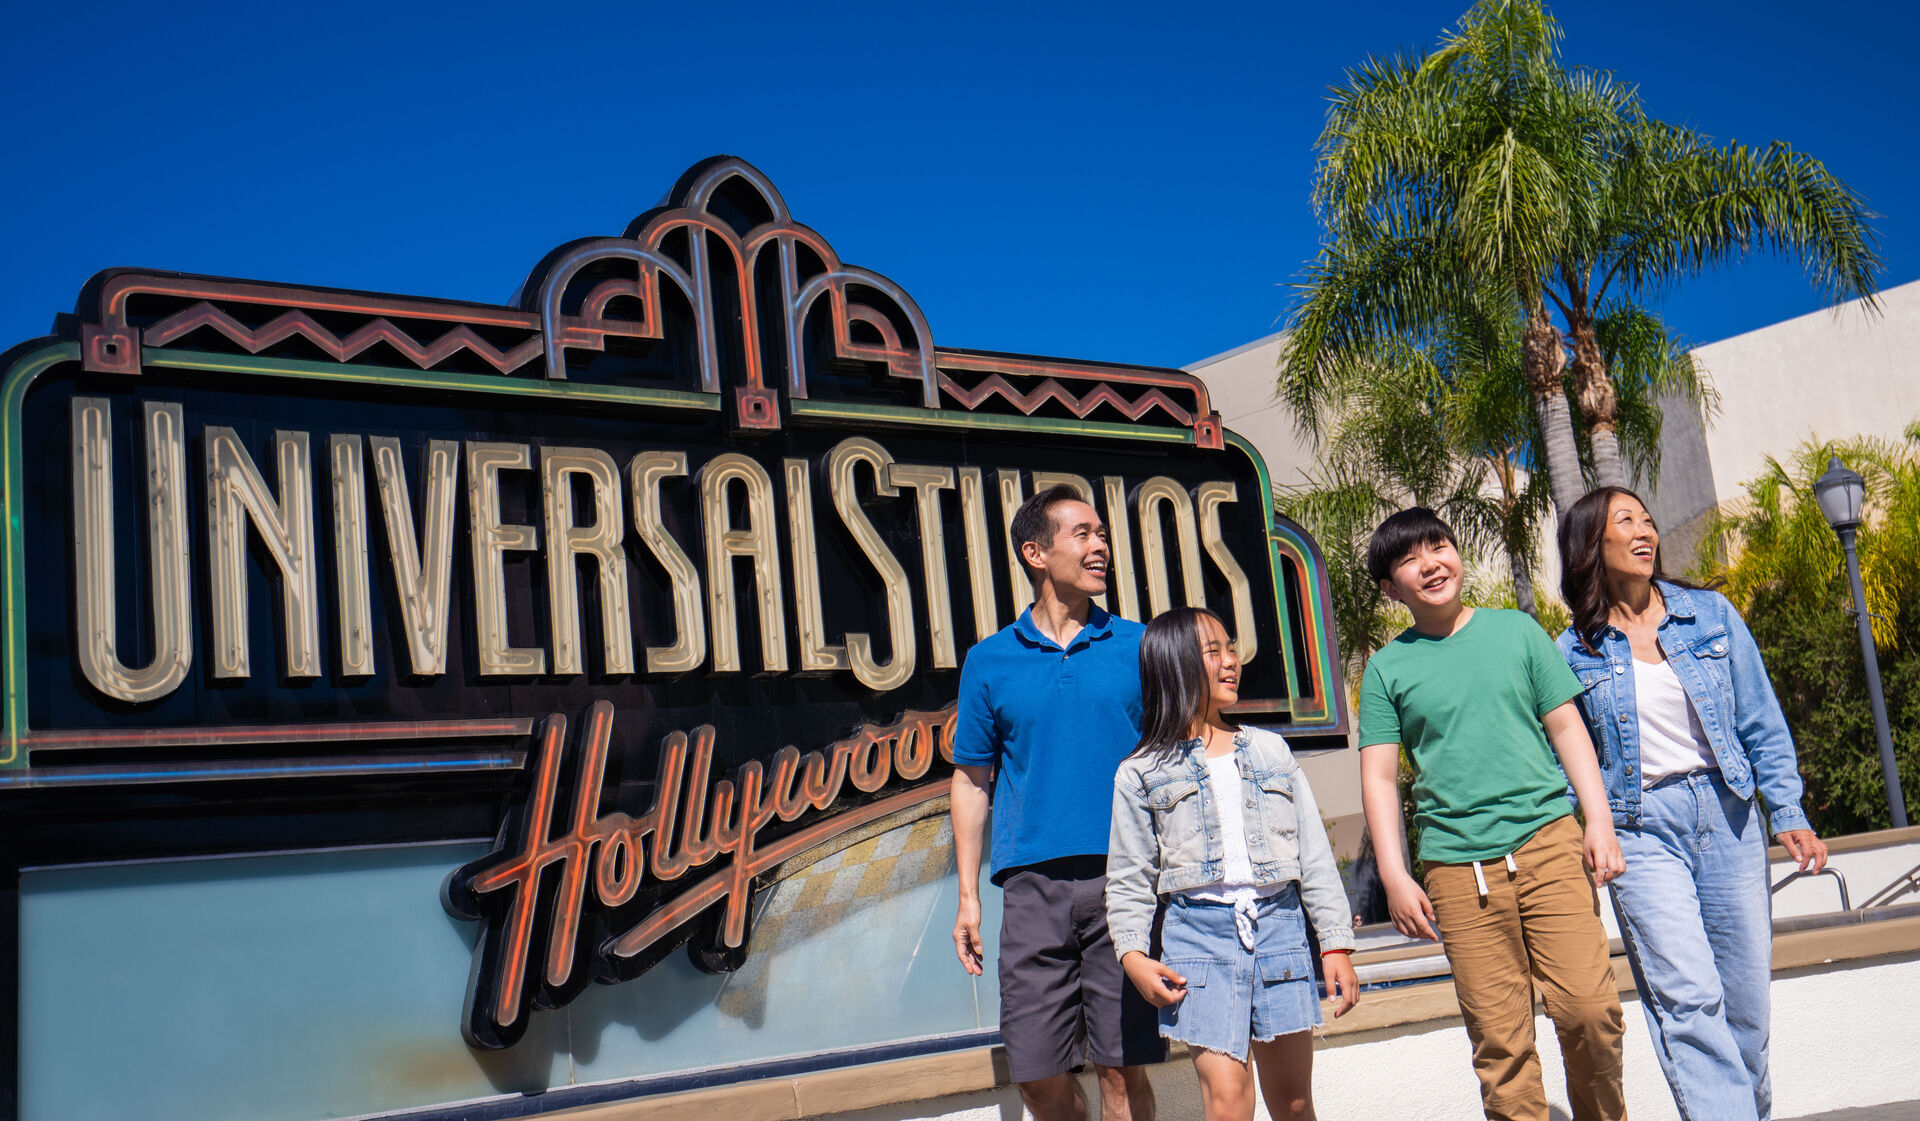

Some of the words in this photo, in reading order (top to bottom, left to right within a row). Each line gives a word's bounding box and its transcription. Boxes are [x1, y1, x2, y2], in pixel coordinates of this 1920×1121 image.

[71, 396, 850, 703] UNIVERSAL
[828, 436, 1258, 691] STUIOS
[472, 699, 958, 1028] Hollywoo
